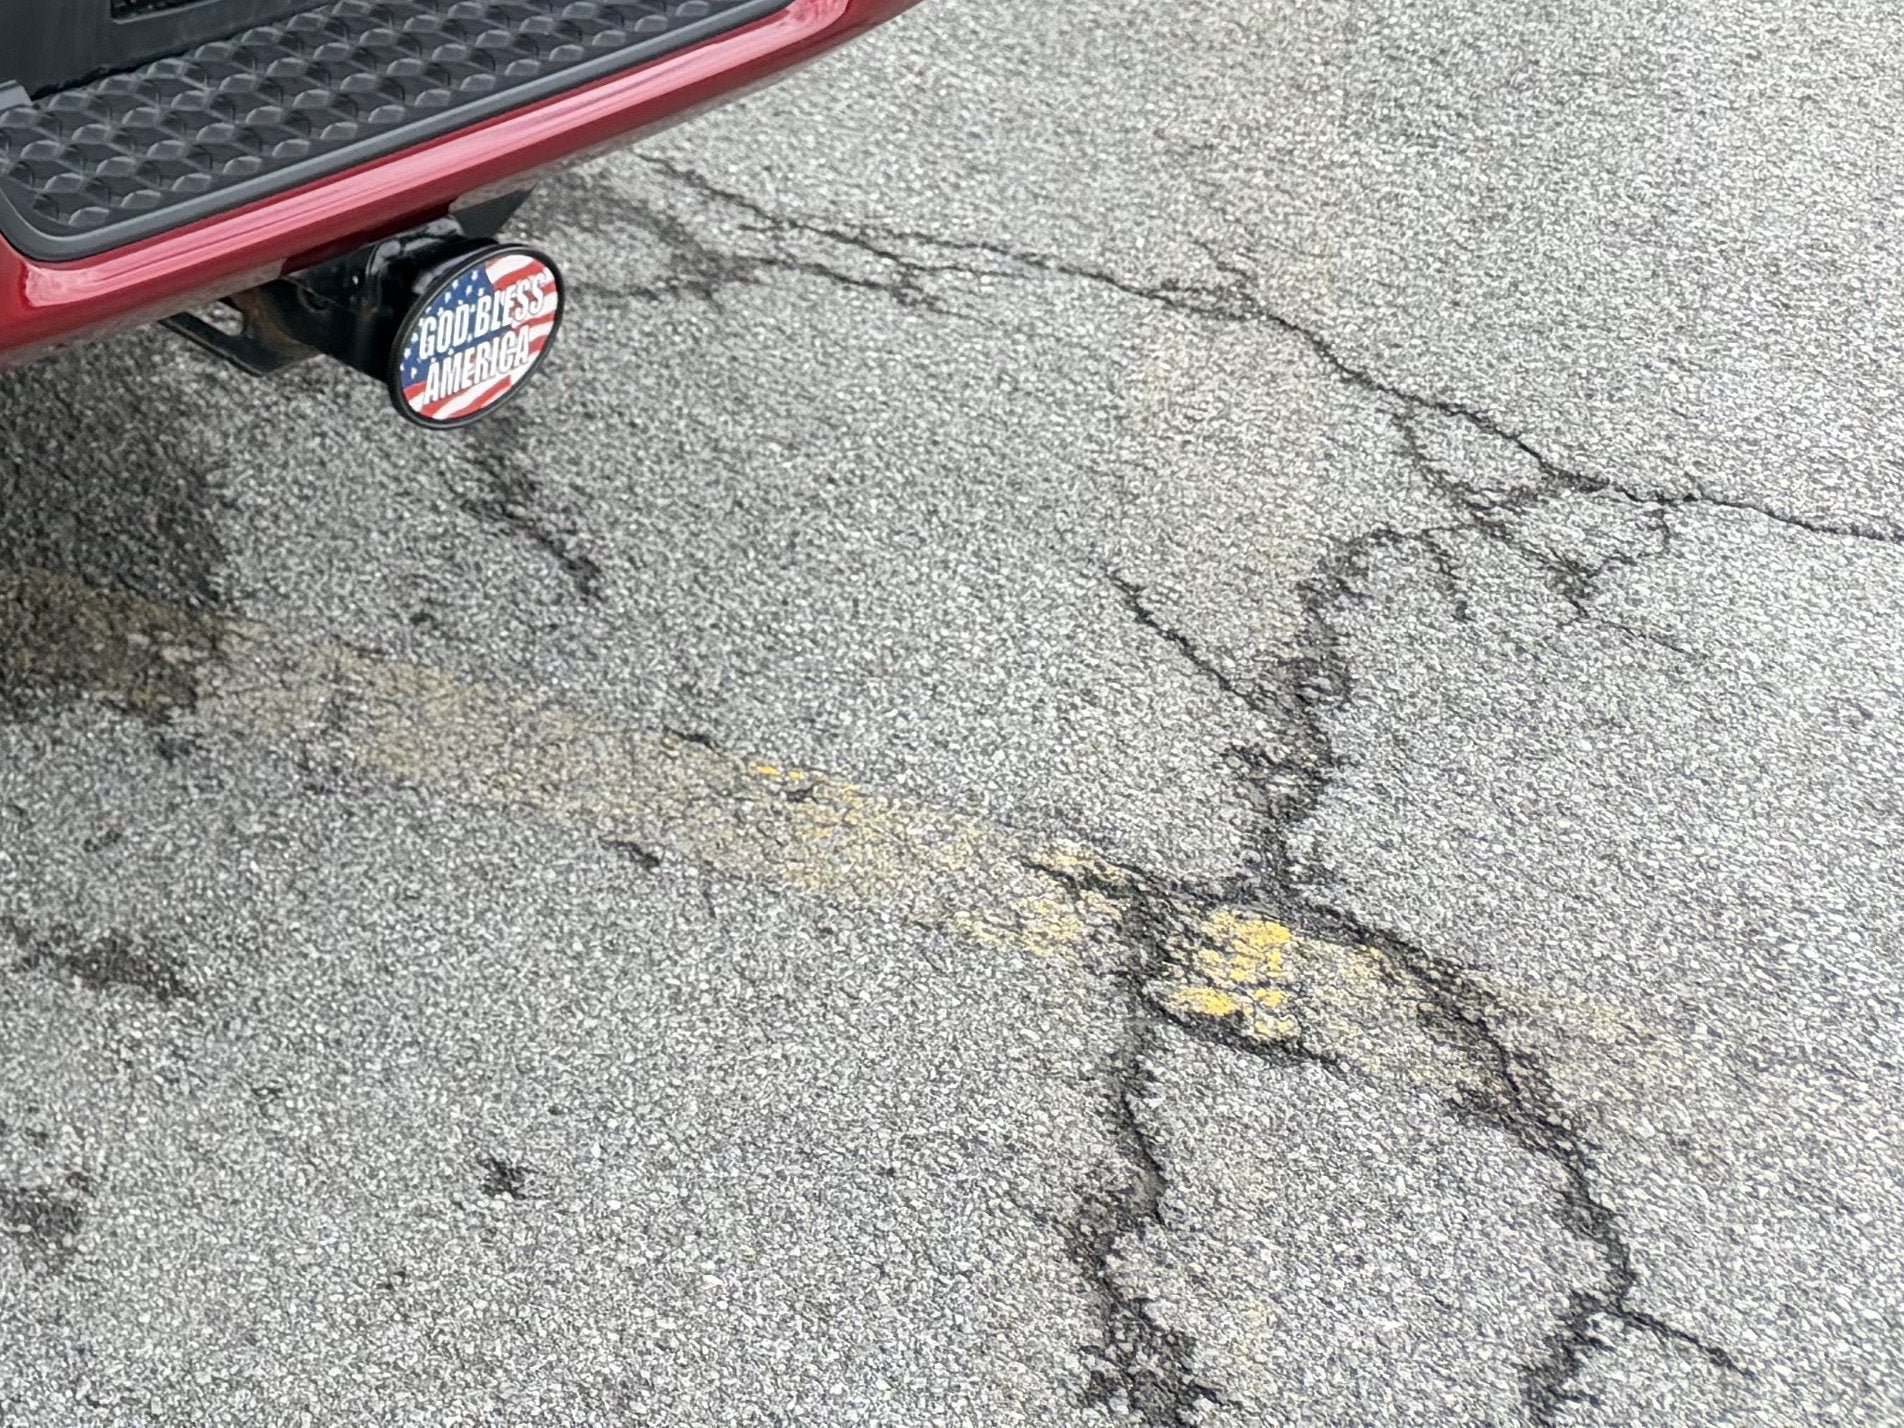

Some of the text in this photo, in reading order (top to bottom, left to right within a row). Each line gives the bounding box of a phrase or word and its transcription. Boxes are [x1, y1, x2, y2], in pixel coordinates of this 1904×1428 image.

[418, 271, 545, 360] GOD BLESS
[422, 324, 531, 405] AMERICA
